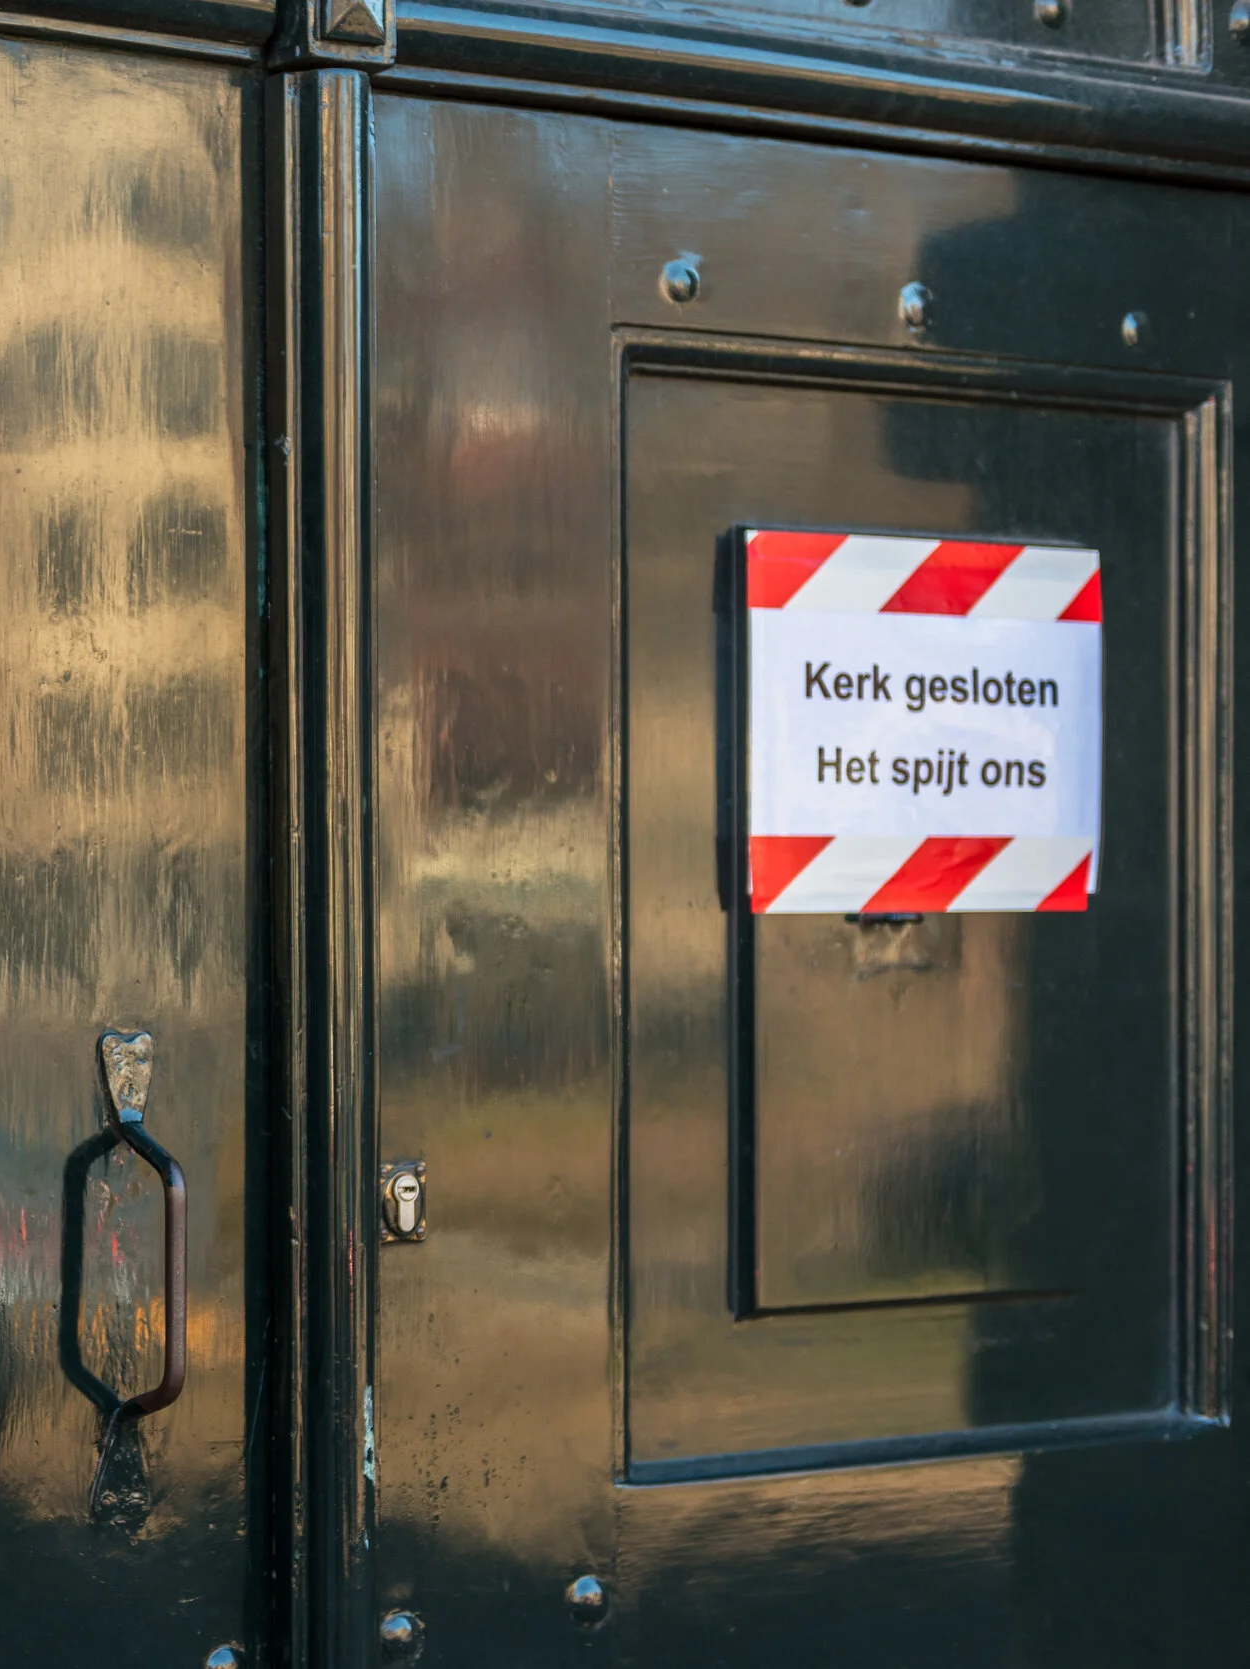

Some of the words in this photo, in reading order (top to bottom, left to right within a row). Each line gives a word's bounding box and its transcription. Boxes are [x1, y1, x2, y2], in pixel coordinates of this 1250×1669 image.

[804, 660, 892, 701] Kerk
[904, 667, 1060, 713] gesloten
[817, 746, 879, 785] Het
[891, 748, 969, 796] spijt
[981, 759, 1047, 789] ons
